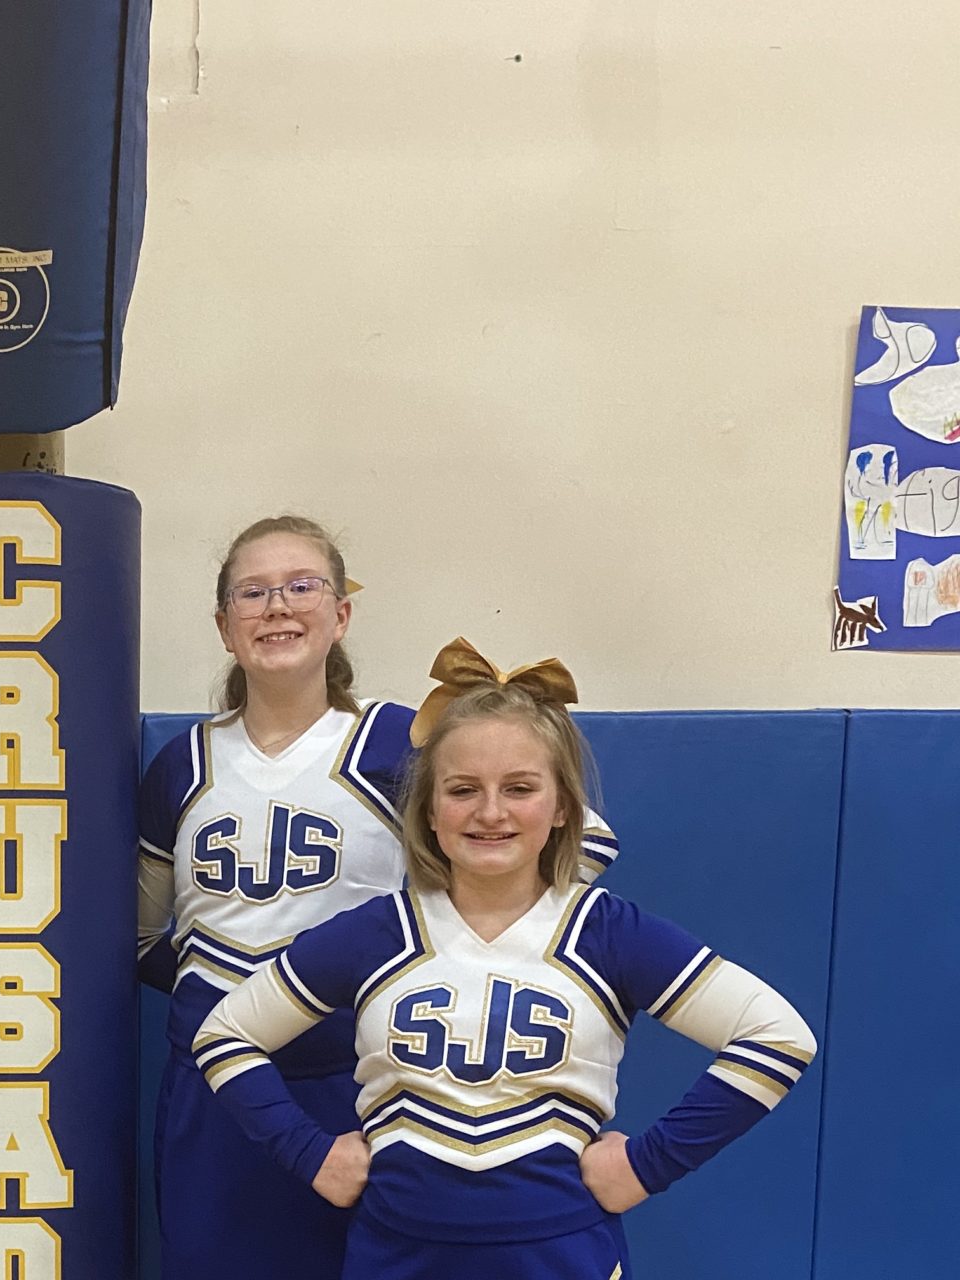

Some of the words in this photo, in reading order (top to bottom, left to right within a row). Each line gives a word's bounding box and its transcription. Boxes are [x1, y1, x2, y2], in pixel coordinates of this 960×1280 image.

[5, 256, 28, 264] MATS
[191, 799, 344, 906] SJS
[388, 972, 575, 1087] SJS
